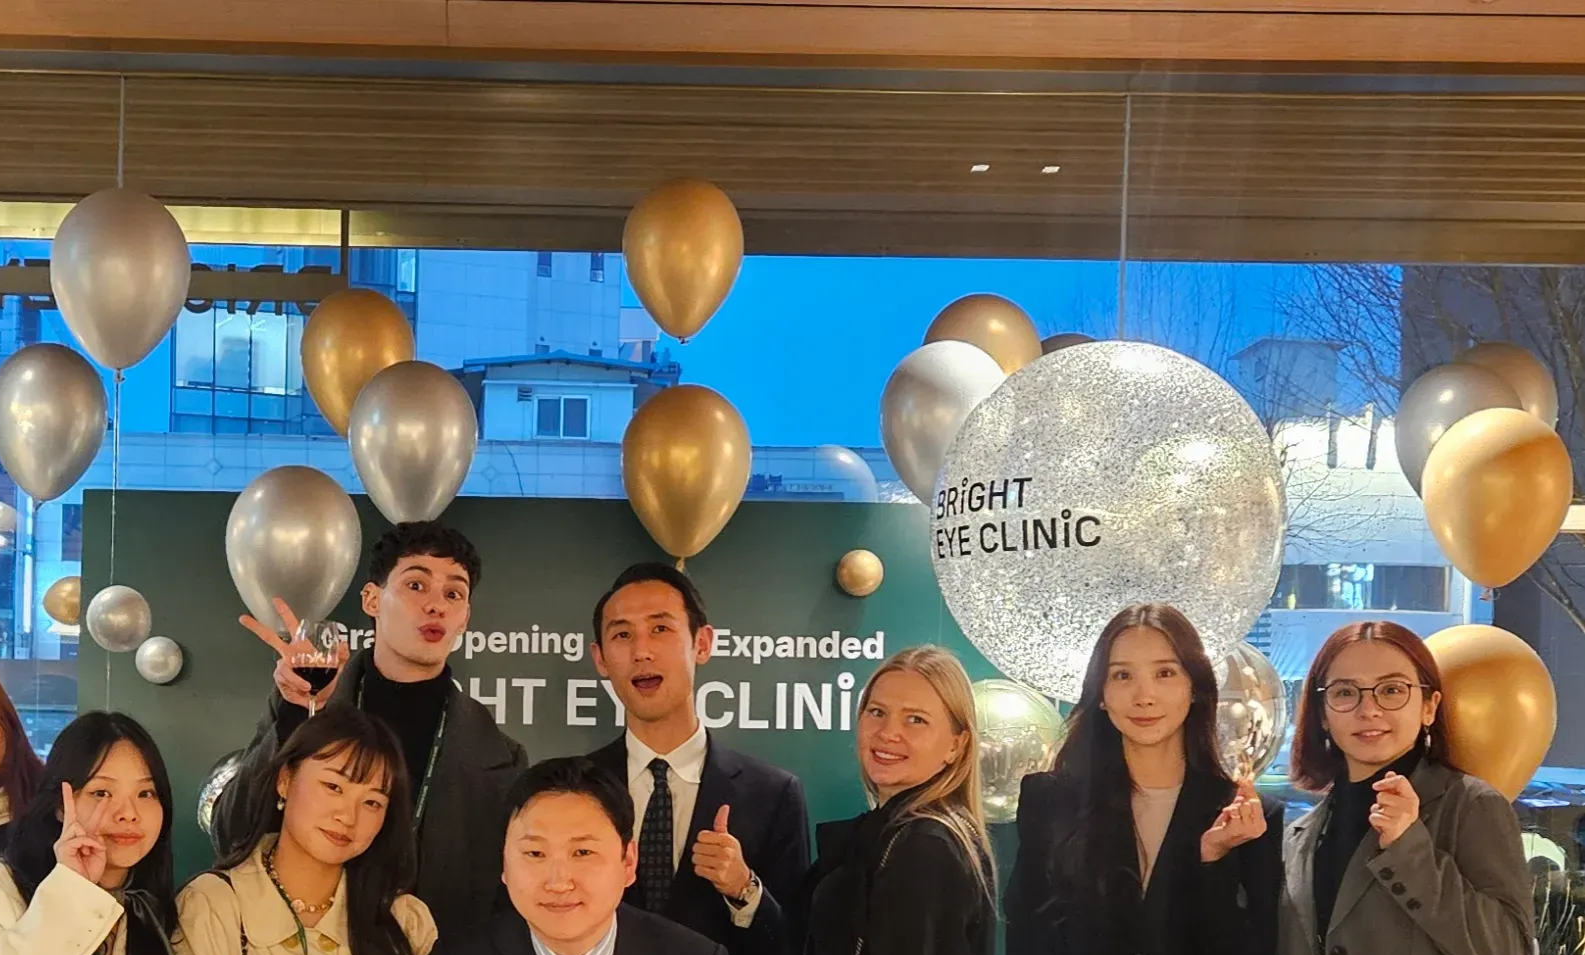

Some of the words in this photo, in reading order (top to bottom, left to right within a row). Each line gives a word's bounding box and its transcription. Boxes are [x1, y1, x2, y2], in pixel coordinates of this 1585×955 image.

[936, 525, 972, 559] EYE
[452, 624, 584, 661] pening
[711, 628, 885, 665] Expanded
[696, 671, 864, 731] CLINi
